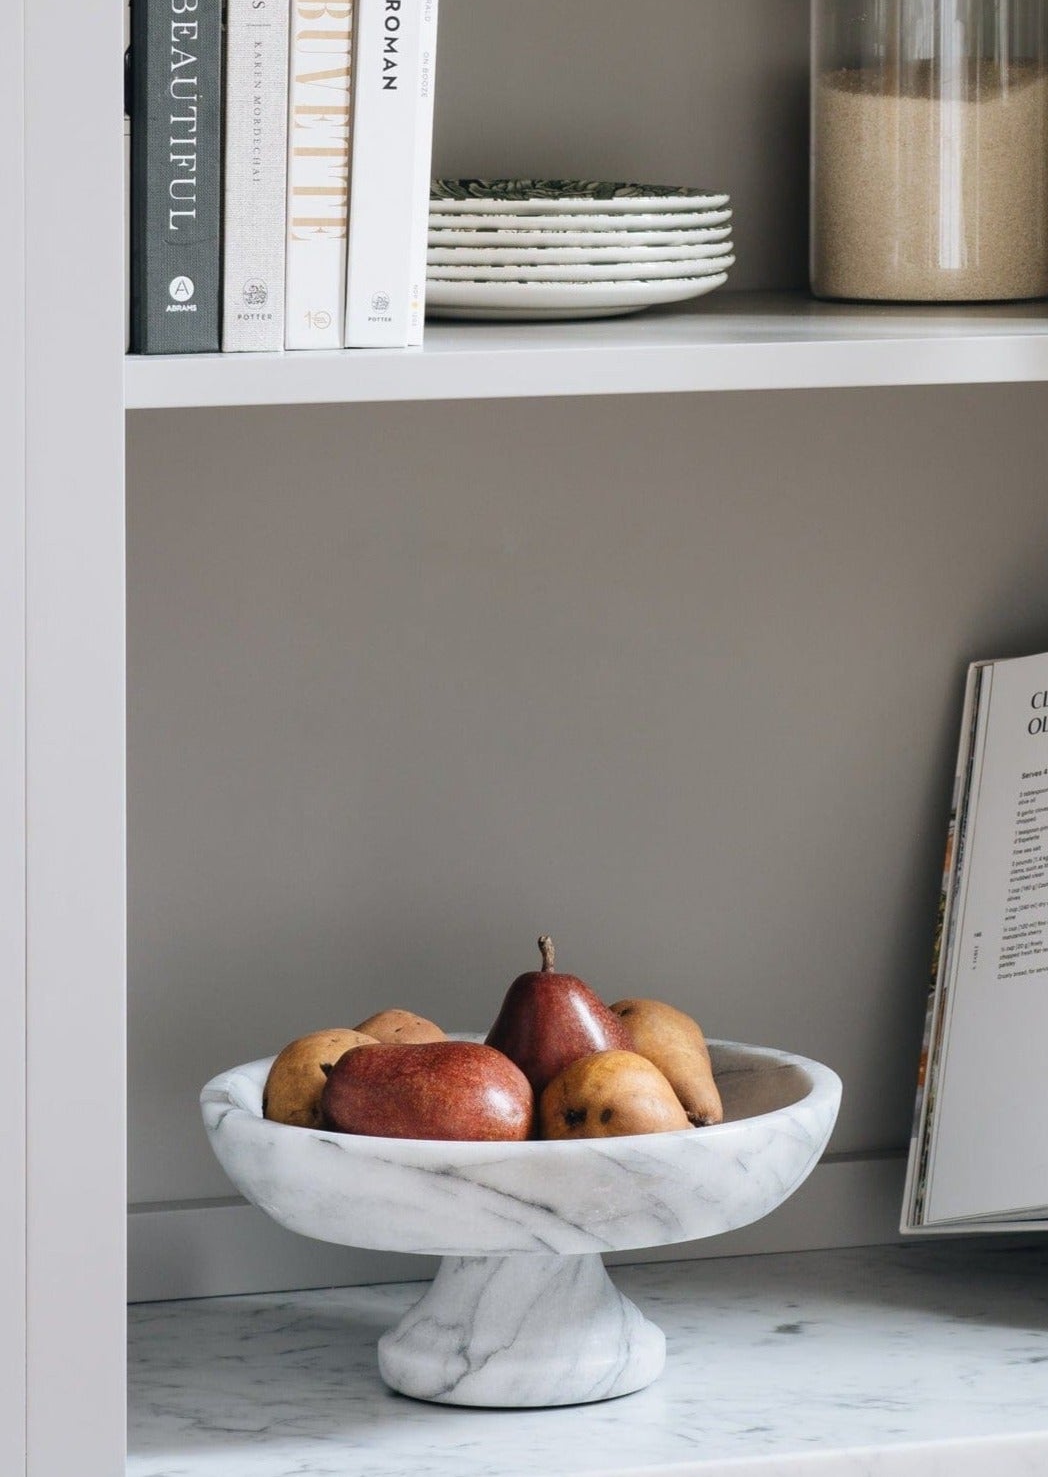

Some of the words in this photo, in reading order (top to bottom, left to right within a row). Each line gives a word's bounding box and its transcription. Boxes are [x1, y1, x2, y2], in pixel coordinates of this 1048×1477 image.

[383, 0, 401, 89] ROMAN
[254, 41, 263, 89] KAREN
[423, 51, 430, 64] ON
[421, 67, 429, 98] BOOZE
[253, 96, 262, 182] MORDECHAI
[166, 304, 197, 312] ABRAMS
[238, 313, 272, 321] POTTER
[1022, 770, 1042, 779] Serves
